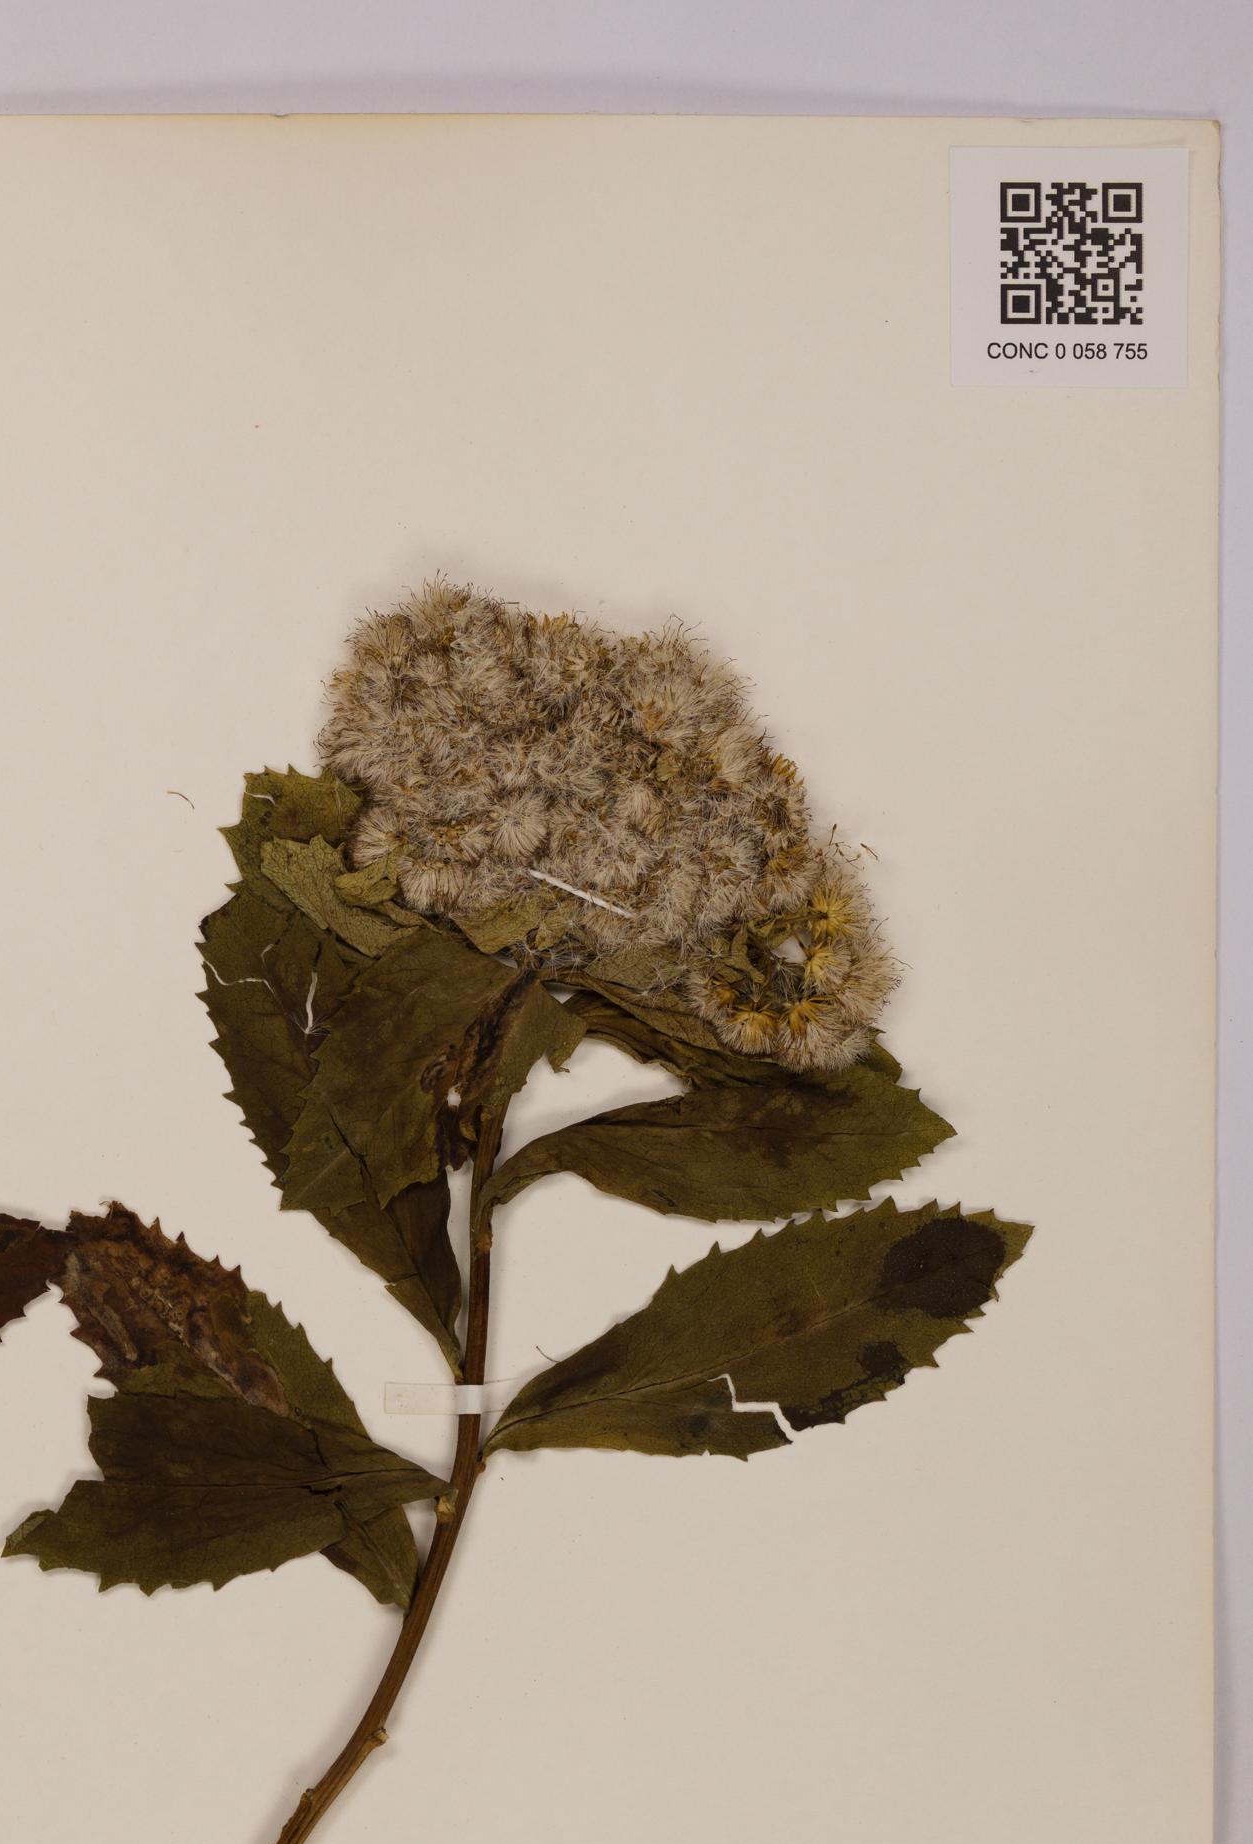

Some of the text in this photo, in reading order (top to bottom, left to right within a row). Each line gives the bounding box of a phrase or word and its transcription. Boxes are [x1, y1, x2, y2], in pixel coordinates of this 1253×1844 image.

[987, 342, 1148, 360] CONC 0 058 755
